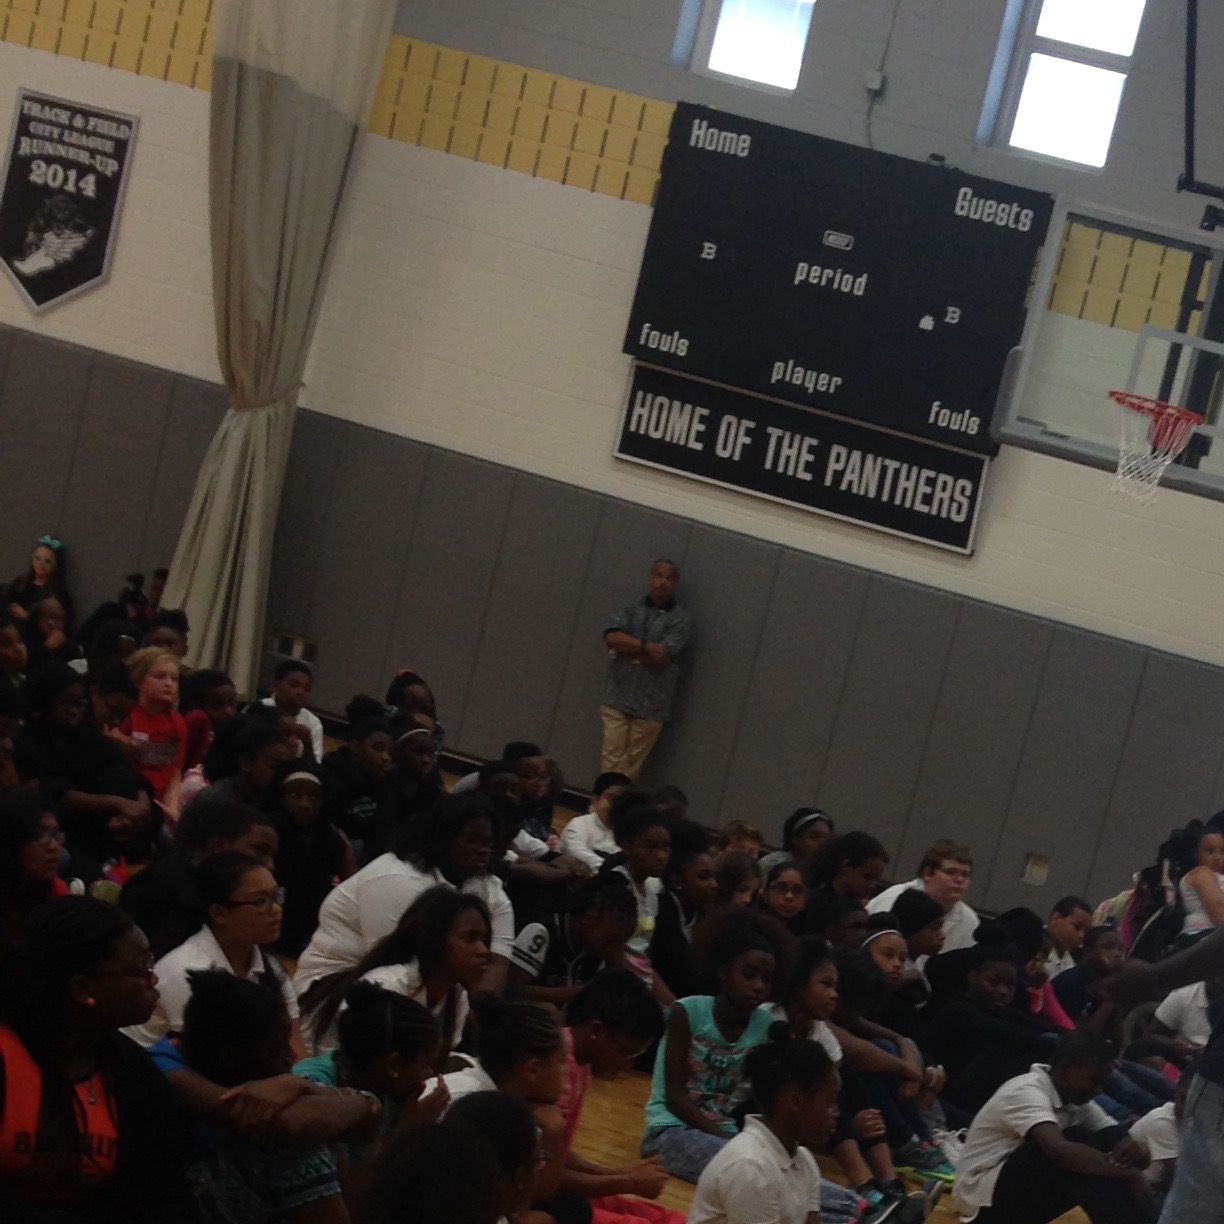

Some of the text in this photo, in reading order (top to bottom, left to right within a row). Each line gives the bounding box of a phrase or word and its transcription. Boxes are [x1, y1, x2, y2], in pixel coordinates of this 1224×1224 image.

[689, 119, 751, 157] Home
[29, 159, 97, 198] 2014
[954, 187, 1034, 232] Guests
[700, 242, 717, 260] B
[794, 261, 868, 296] period
[944, 306, 961, 324] B
[638, 323, 690, 357] fouls
[770, 358, 842, 394] player
[928, 400, 980, 436] fouls
[629, 390, 973, 524] HOME OF THE PANTHERS
